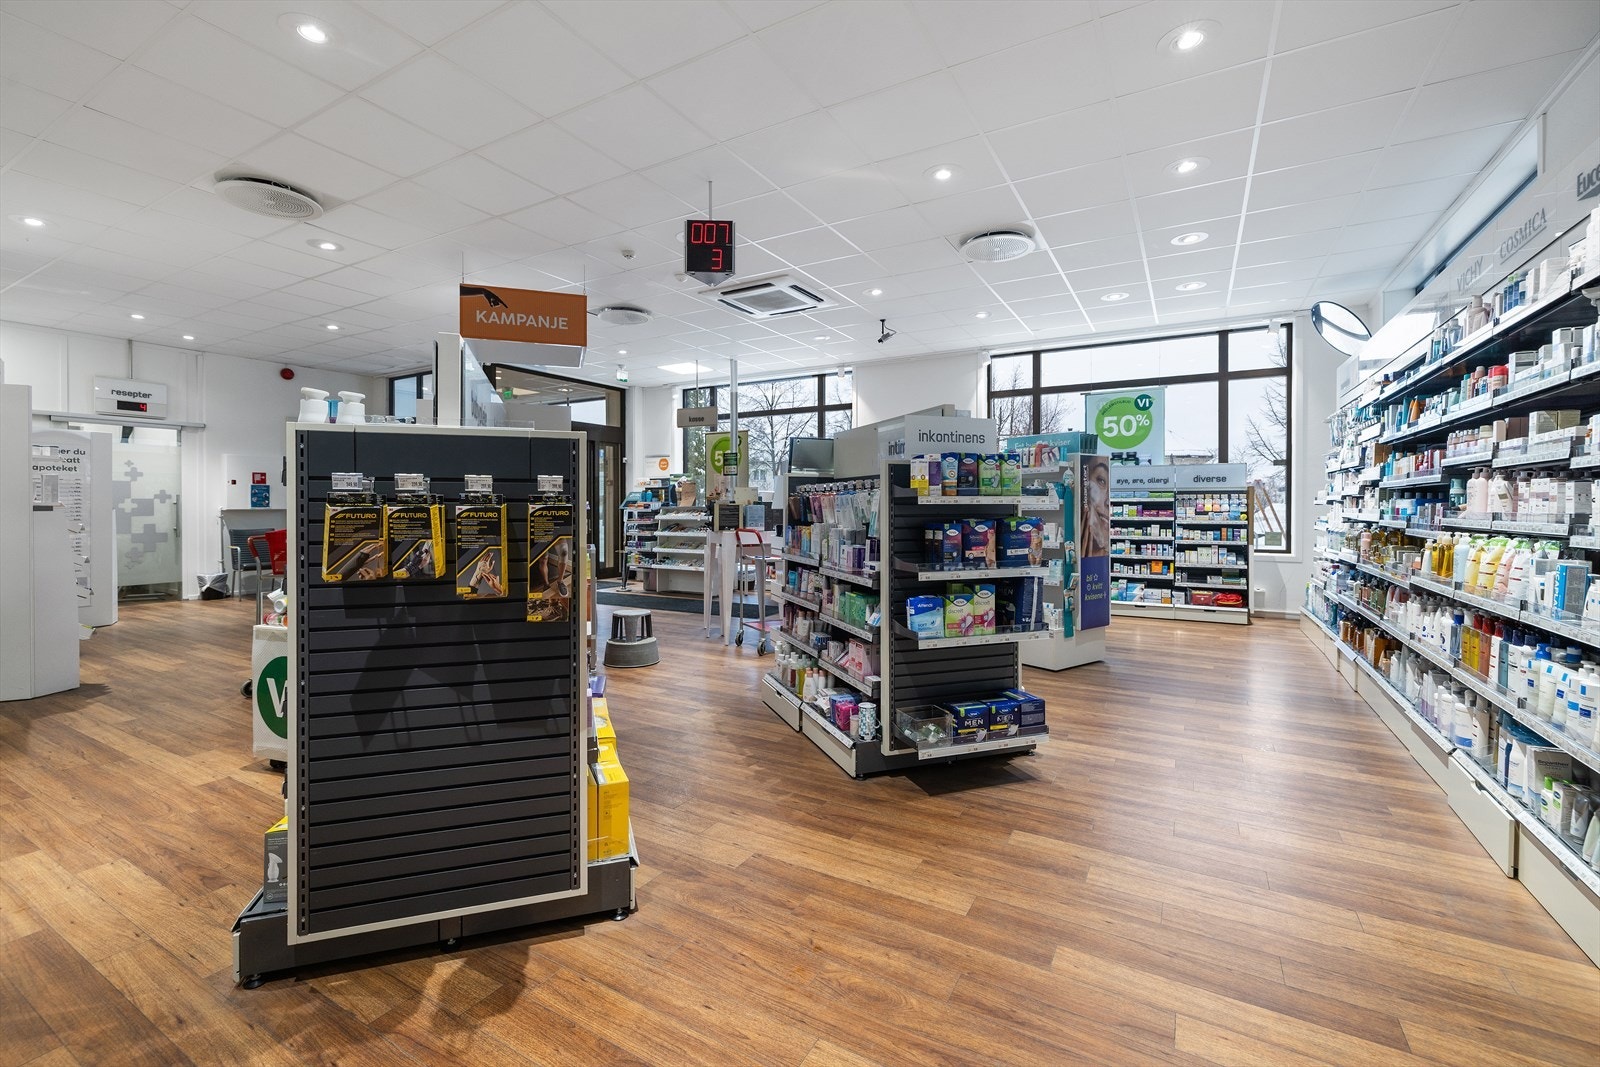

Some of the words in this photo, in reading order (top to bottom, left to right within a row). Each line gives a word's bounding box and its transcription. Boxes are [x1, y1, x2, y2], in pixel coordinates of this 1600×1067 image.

[691, 222, 730, 244] 007
[1500, 208, 1547, 259] COSMICA
[711, 249, 722, 269] 3
[1457, 256, 1483, 291] VICHY
[476, 310, 568, 330] KAMPANJE
[111, 389, 152, 399] resepter
[1137, 398, 1149, 407] VI
[1103, 414, 1150, 438] 50%
[918, 429, 985, 444] inkontinens
[1193, 475, 1227, 483] diverse
[964, 719, 984, 727] MEN
